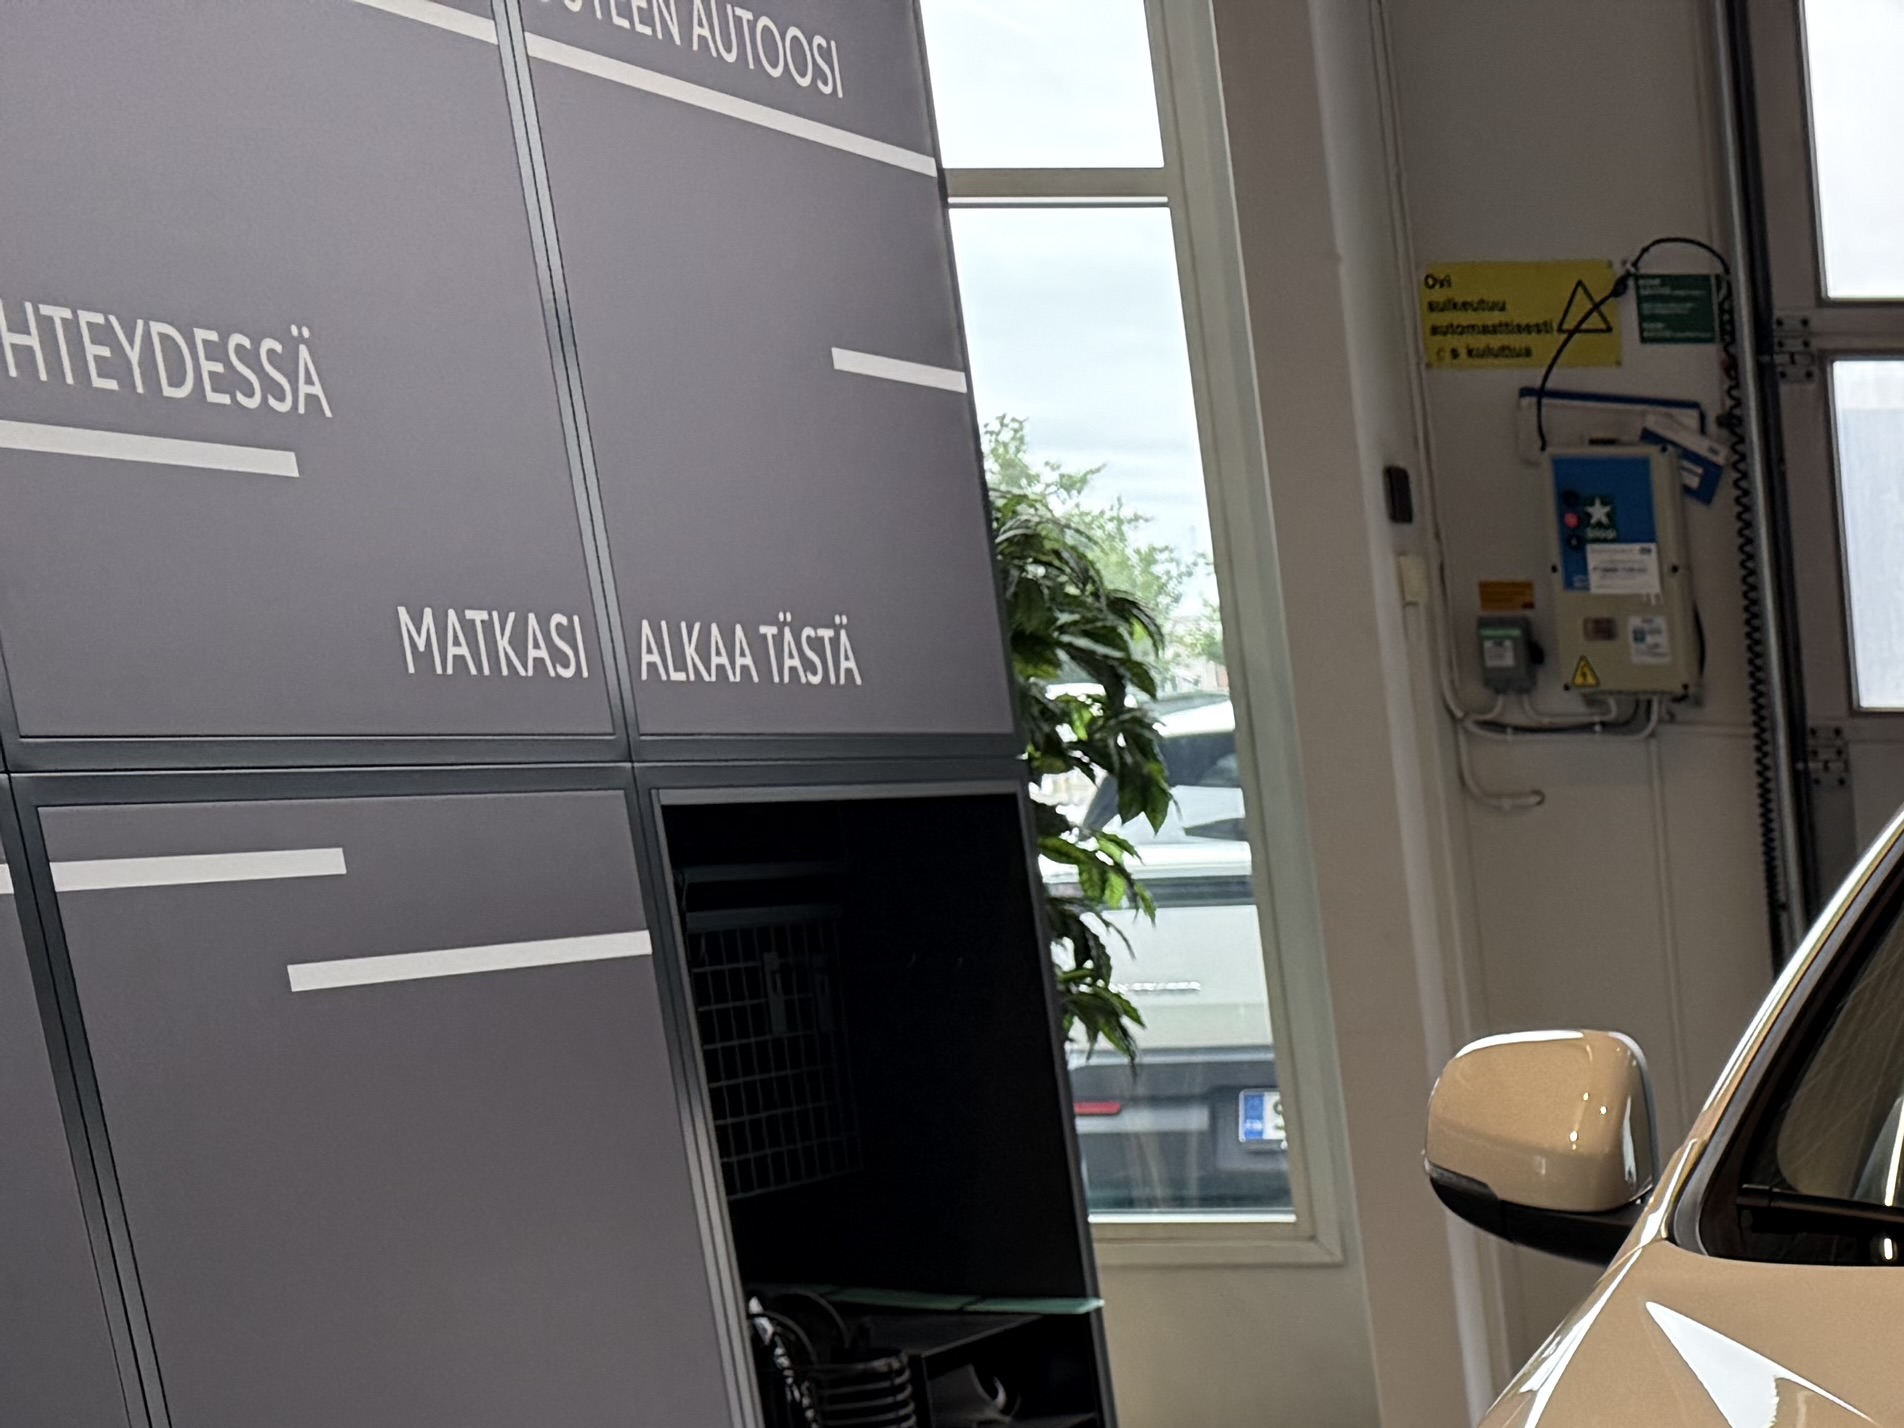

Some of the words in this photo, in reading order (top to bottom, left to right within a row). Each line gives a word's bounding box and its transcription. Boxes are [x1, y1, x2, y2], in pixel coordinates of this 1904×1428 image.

[692, 0, 843, 98] AUTOOSI
[1424, 274, 1451, 289] Ovi
[397, 605, 588, 679] MATKASI
[640, 619, 759, 683] ALKAA
[759, 611, 862, 686] TÄSTÄ
